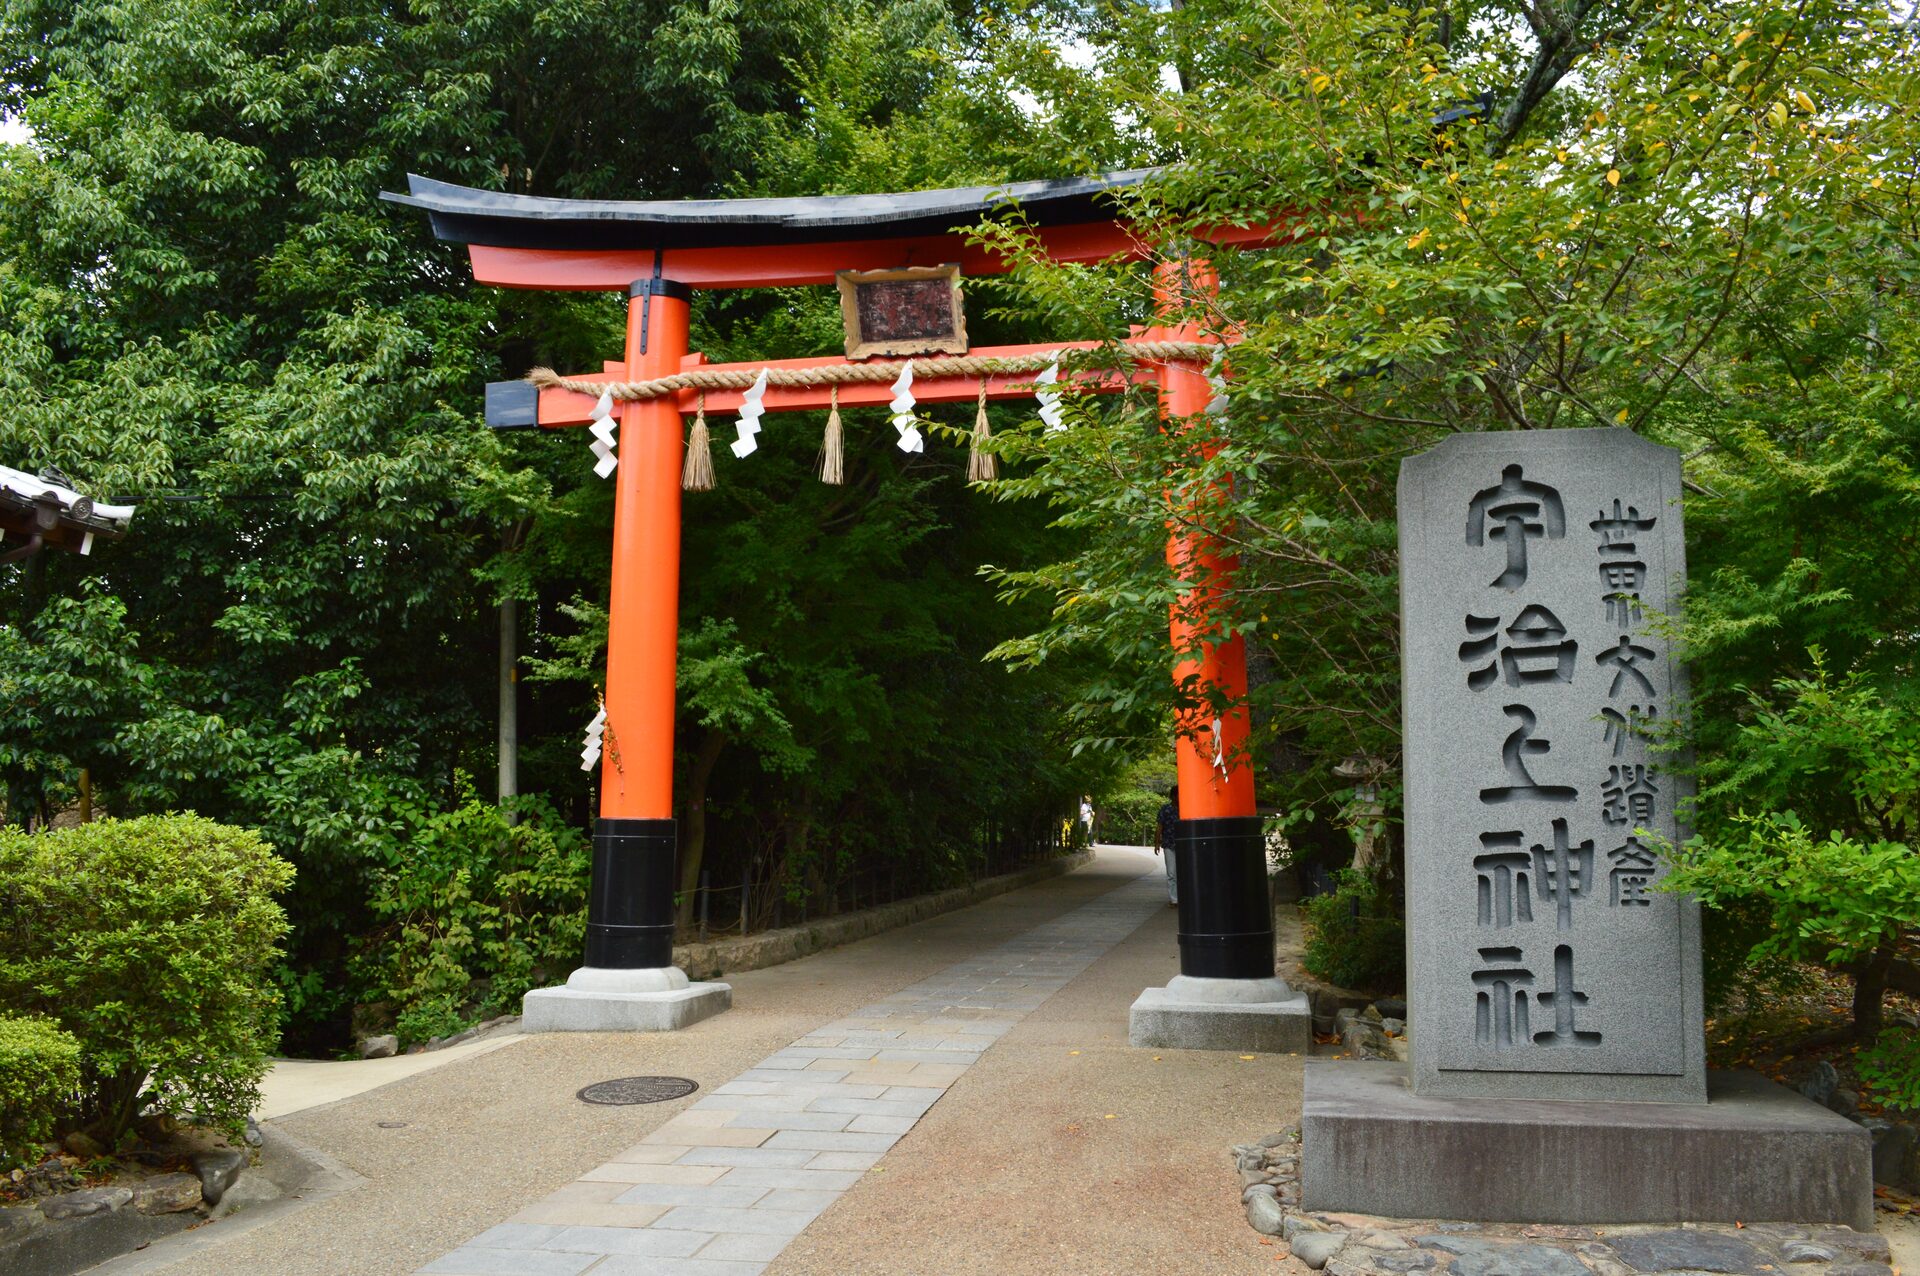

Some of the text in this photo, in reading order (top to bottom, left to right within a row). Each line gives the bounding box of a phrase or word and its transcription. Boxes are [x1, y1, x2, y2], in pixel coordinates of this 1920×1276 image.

[1458, 463, 1602, 1047] 宇治上神社
